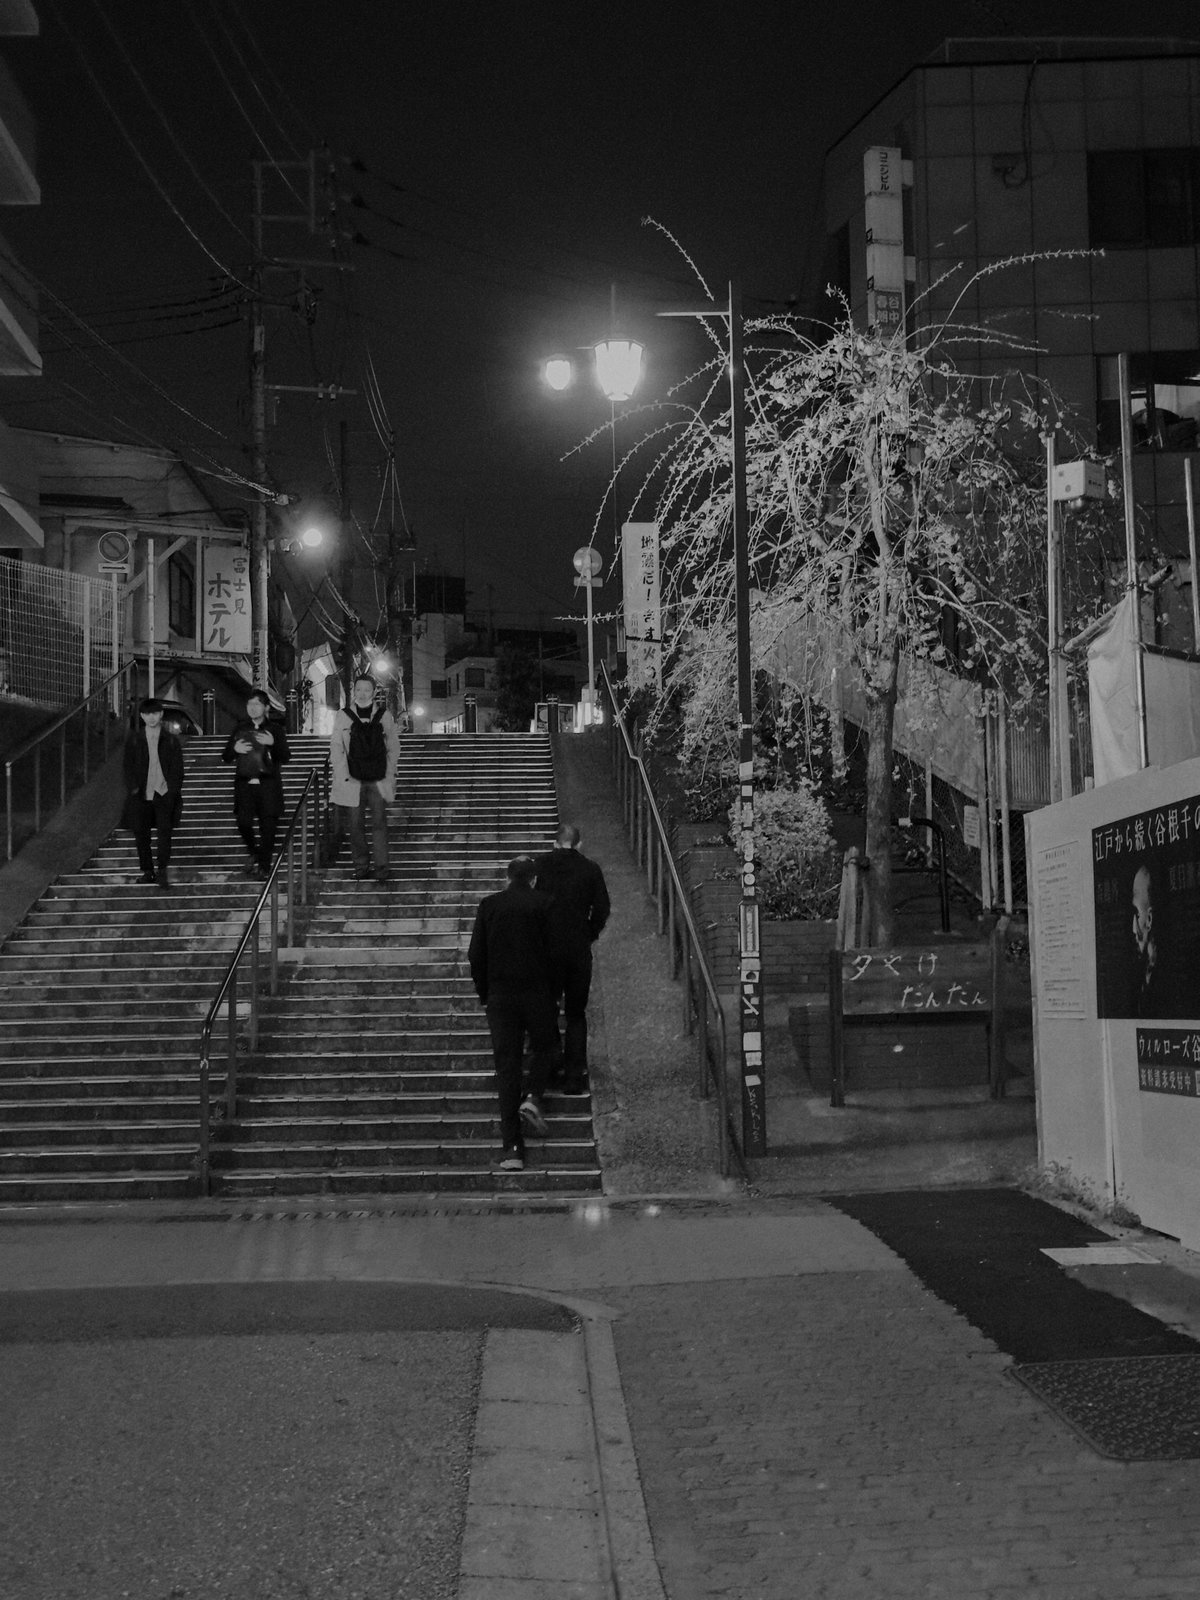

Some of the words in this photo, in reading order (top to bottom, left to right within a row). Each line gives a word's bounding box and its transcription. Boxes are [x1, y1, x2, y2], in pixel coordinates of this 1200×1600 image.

[233, 557, 247, 615] 富士見
[208, 572, 232, 648] ホテル
[850, 953, 938, 981] 夕やけ
[901, 982, 987, 1008] だんだん
